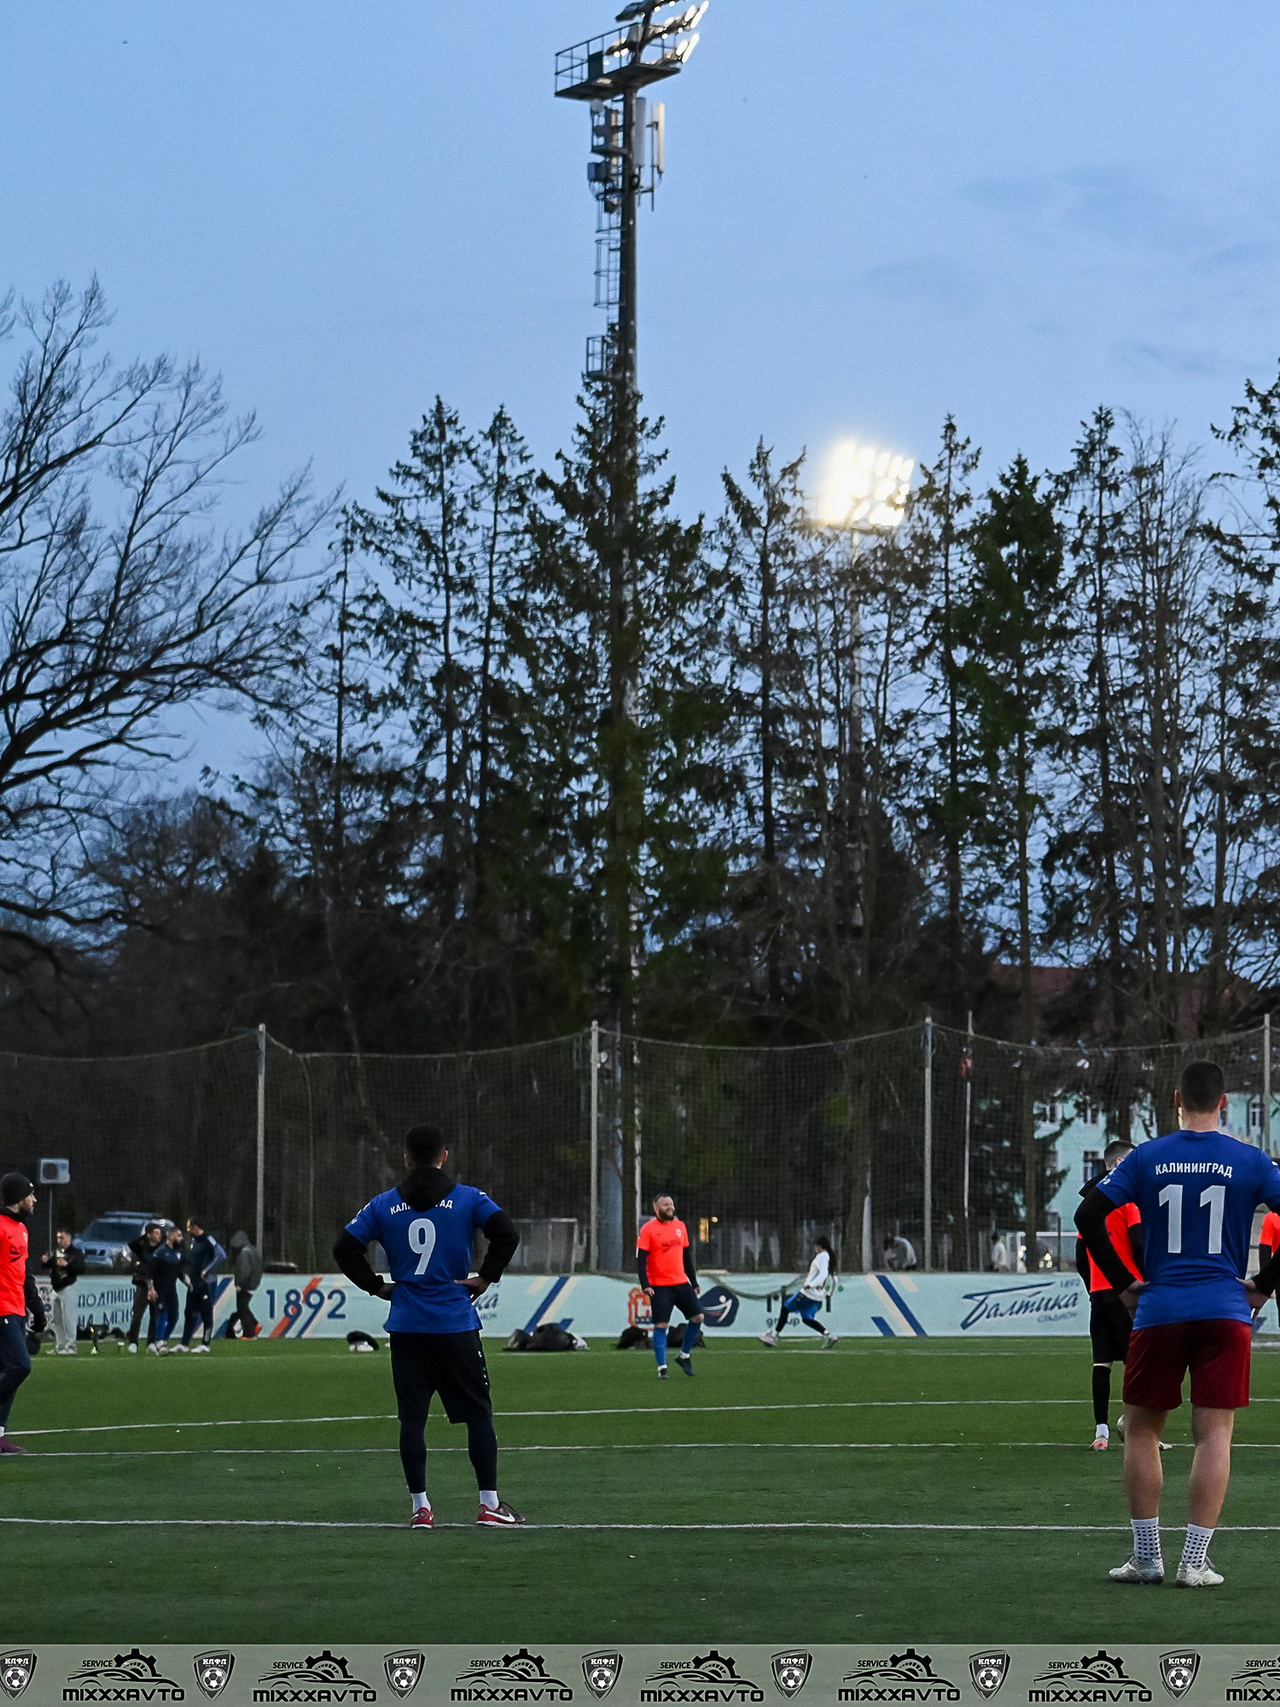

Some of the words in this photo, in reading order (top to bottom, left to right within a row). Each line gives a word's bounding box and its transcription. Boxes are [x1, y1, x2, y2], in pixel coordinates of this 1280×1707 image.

[1155, 1162, 1233, 1178] КАЛИНИНГРАД
[1159, 1184, 1226, 1254] 11
[408, 1218, 436, 1275] 9
[266, 1288, 347, 1328] 1892
[960, 1281, 1079, 1330] Балтика
